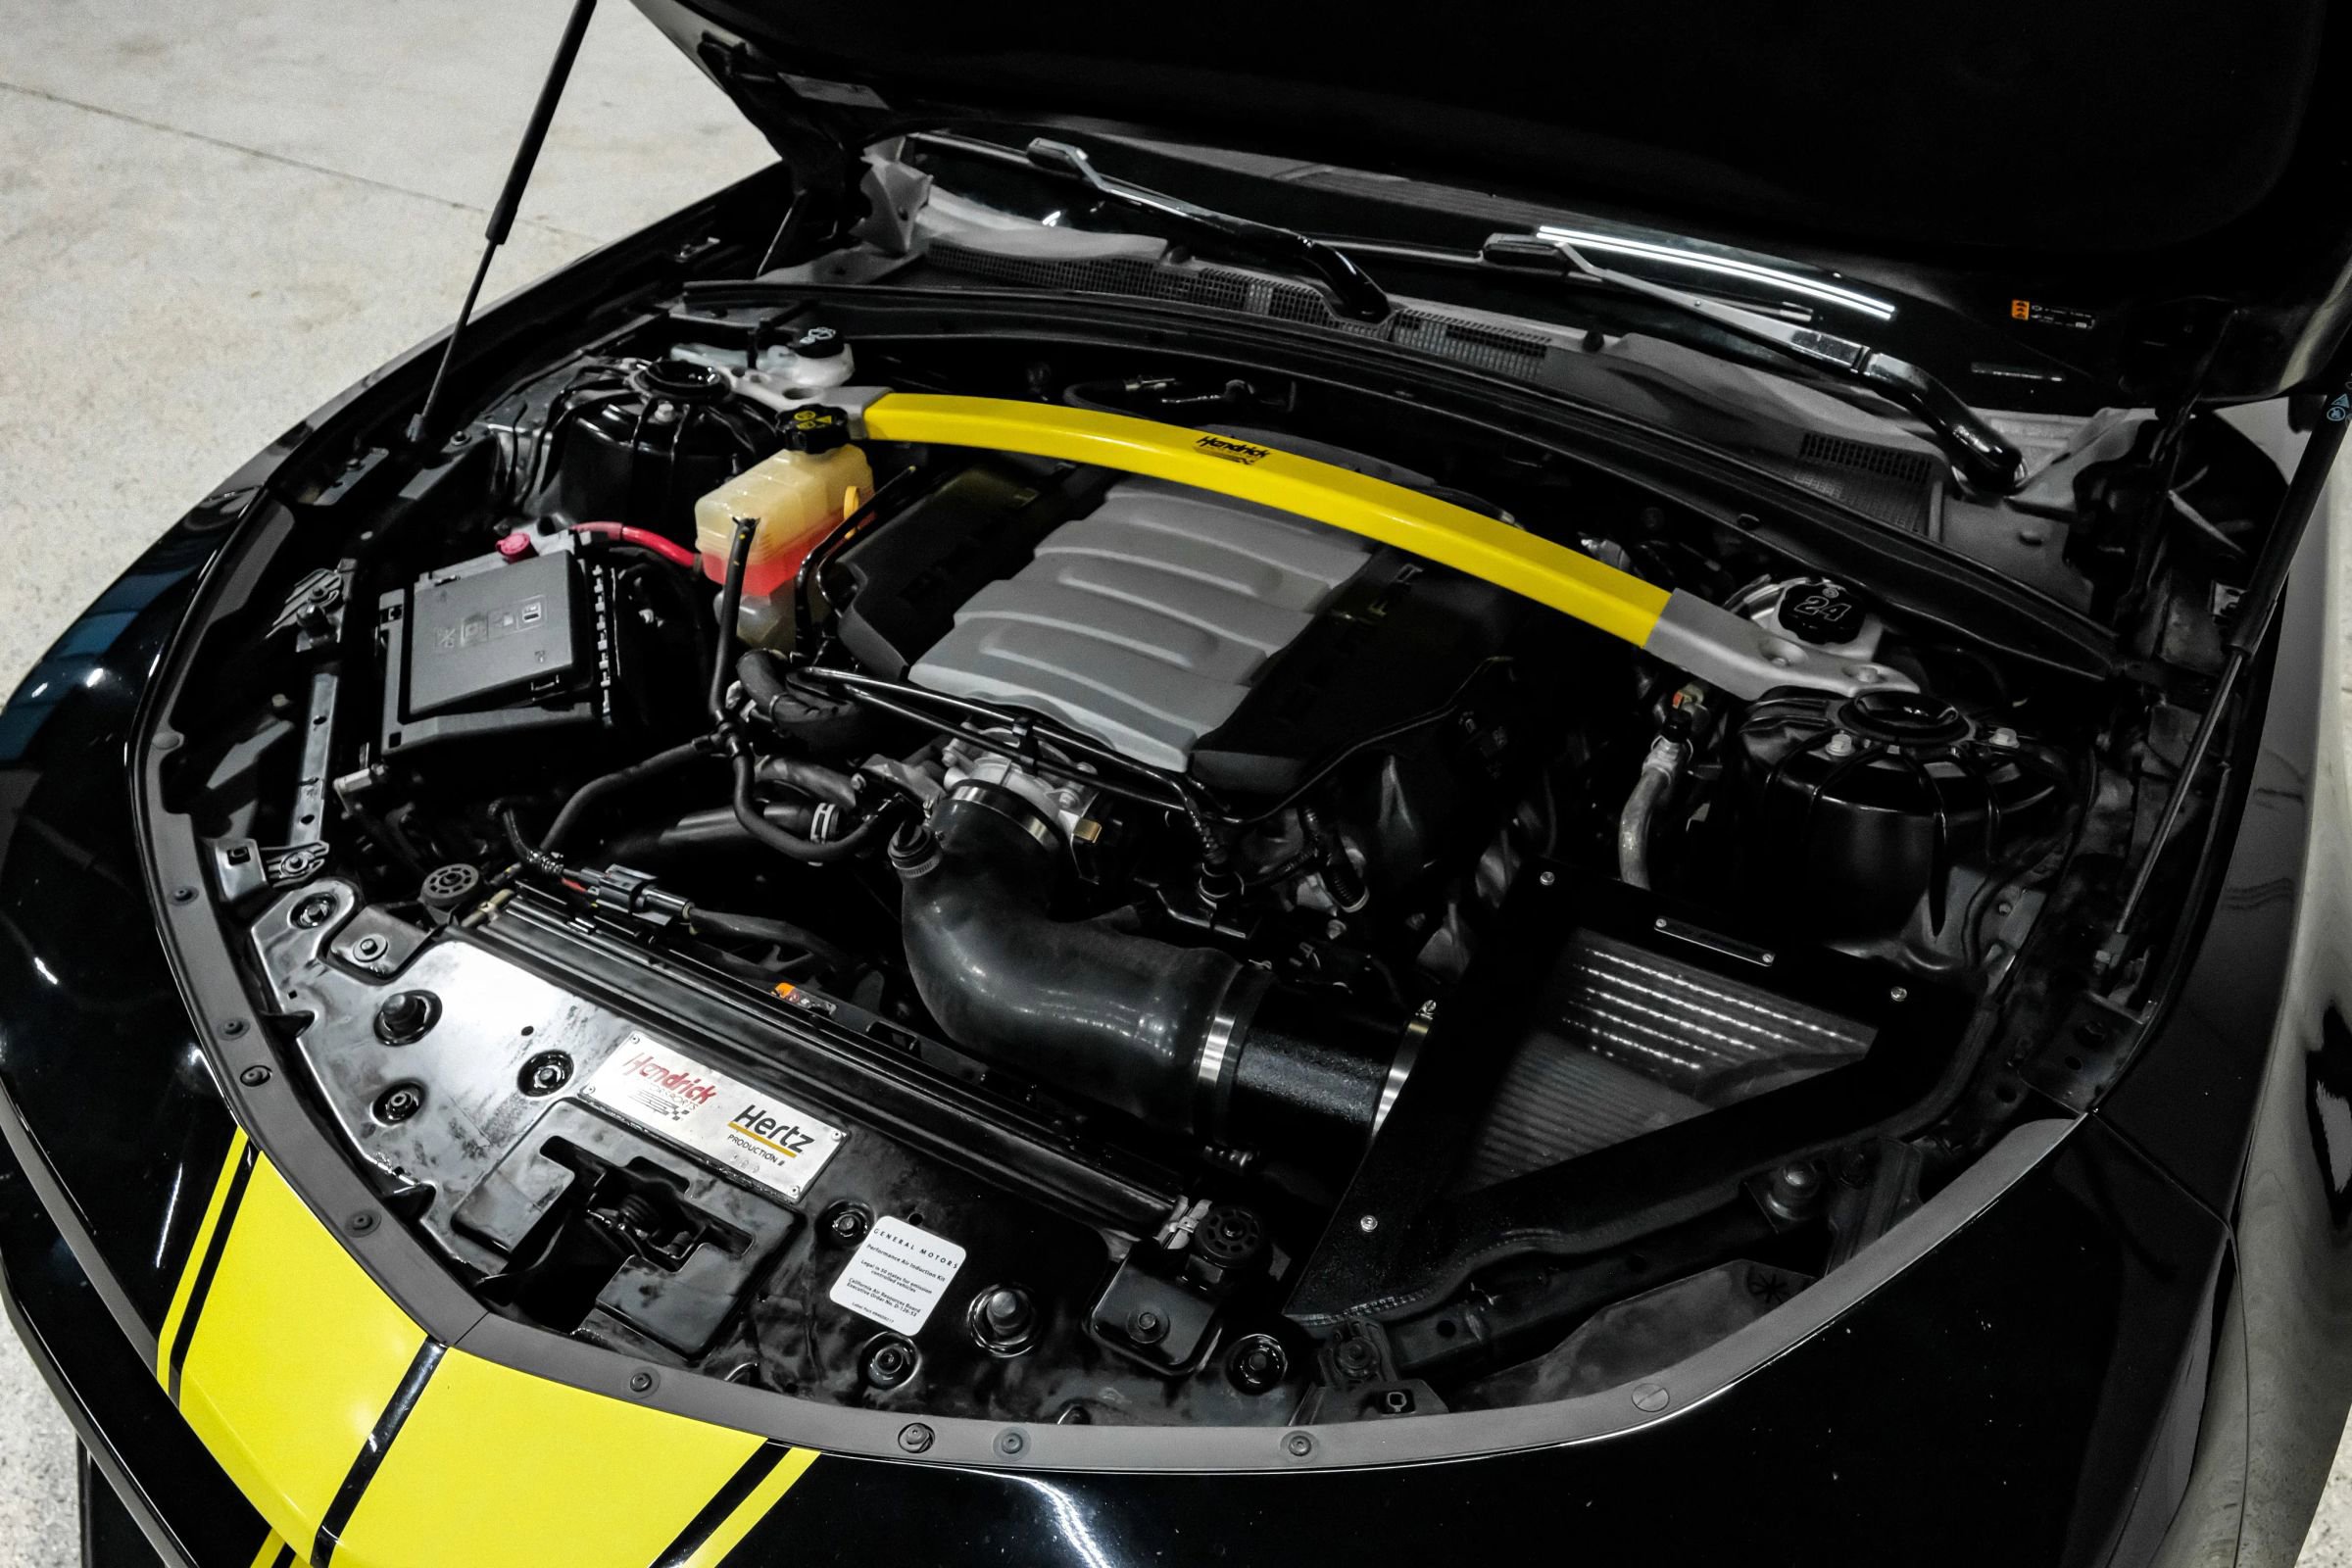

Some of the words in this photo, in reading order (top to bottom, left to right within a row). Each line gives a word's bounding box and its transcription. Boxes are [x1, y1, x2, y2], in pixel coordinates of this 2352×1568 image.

[1197, 436, 1271, 459] Hendrick
[1793, 595, 1852, 622] 24
[622, 1052, 717, 1105] Hendrick
[733, 1104, 815, 1154] Hertz
[727, 1134, 778, 1166] PRODUCTION
[866, 1244, 901, 1262] Performance
[901, 1258, 910, 1267] Air
[910, 1262, 936, 1279] Induction
[936, 1274, 946, 1283] Kit
[873, 1228, 914, 1250] GENERAL
[919, 1249, 958, 1269] MOTORS
[860, 1259, 874, 1270] Legal
[887, 1270, 903, 1283] states
[847, 1282, 870, 1297] Executive
[870, 1293, 885, 1303] Order
[849, 1278, 872, 1292] California
[881, 1291, 906, 1306] Resources
[906, 1302, 921, 1313] Board
